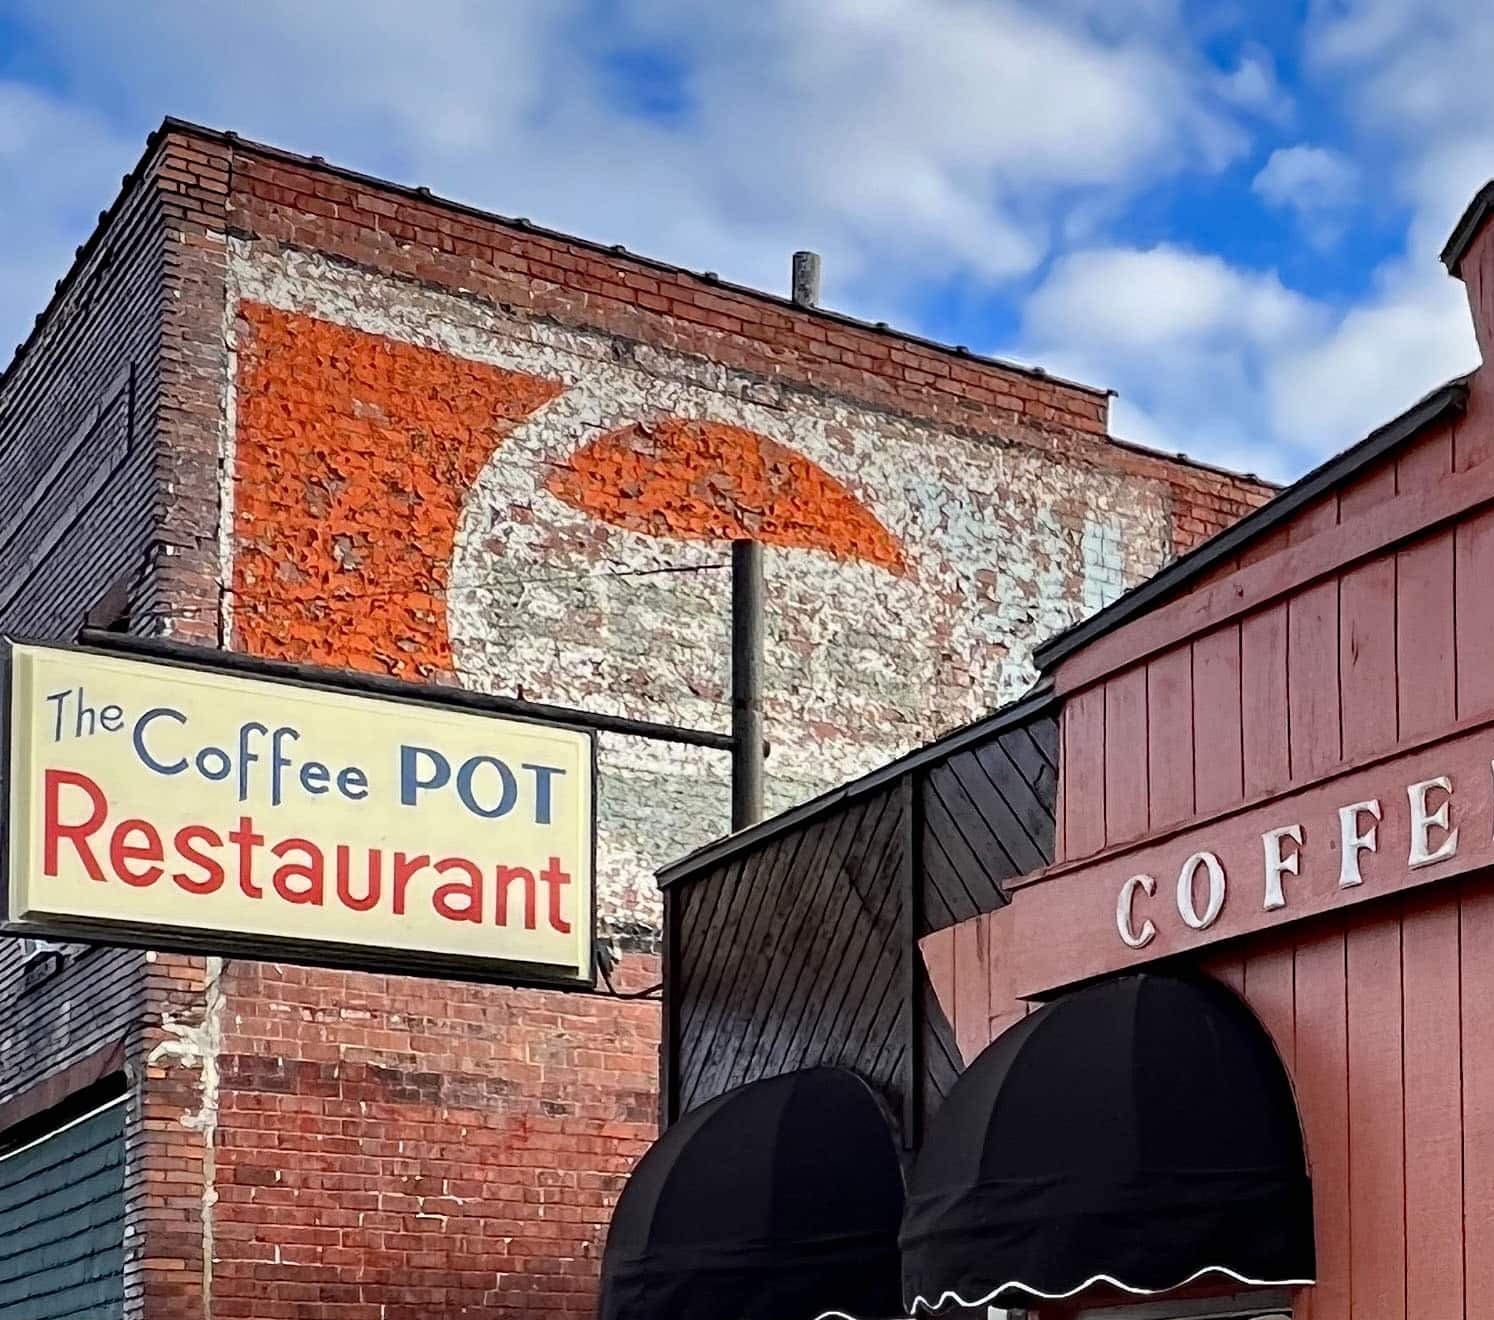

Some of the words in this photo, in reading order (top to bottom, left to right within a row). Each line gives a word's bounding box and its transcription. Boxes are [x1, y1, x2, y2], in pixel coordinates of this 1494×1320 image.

[47, 688, 125, 742] The
[132, 707, 370, 806] Coffee
[400, 744, 567, 826] POT
[44, 769, 572, 935] Restaurant
